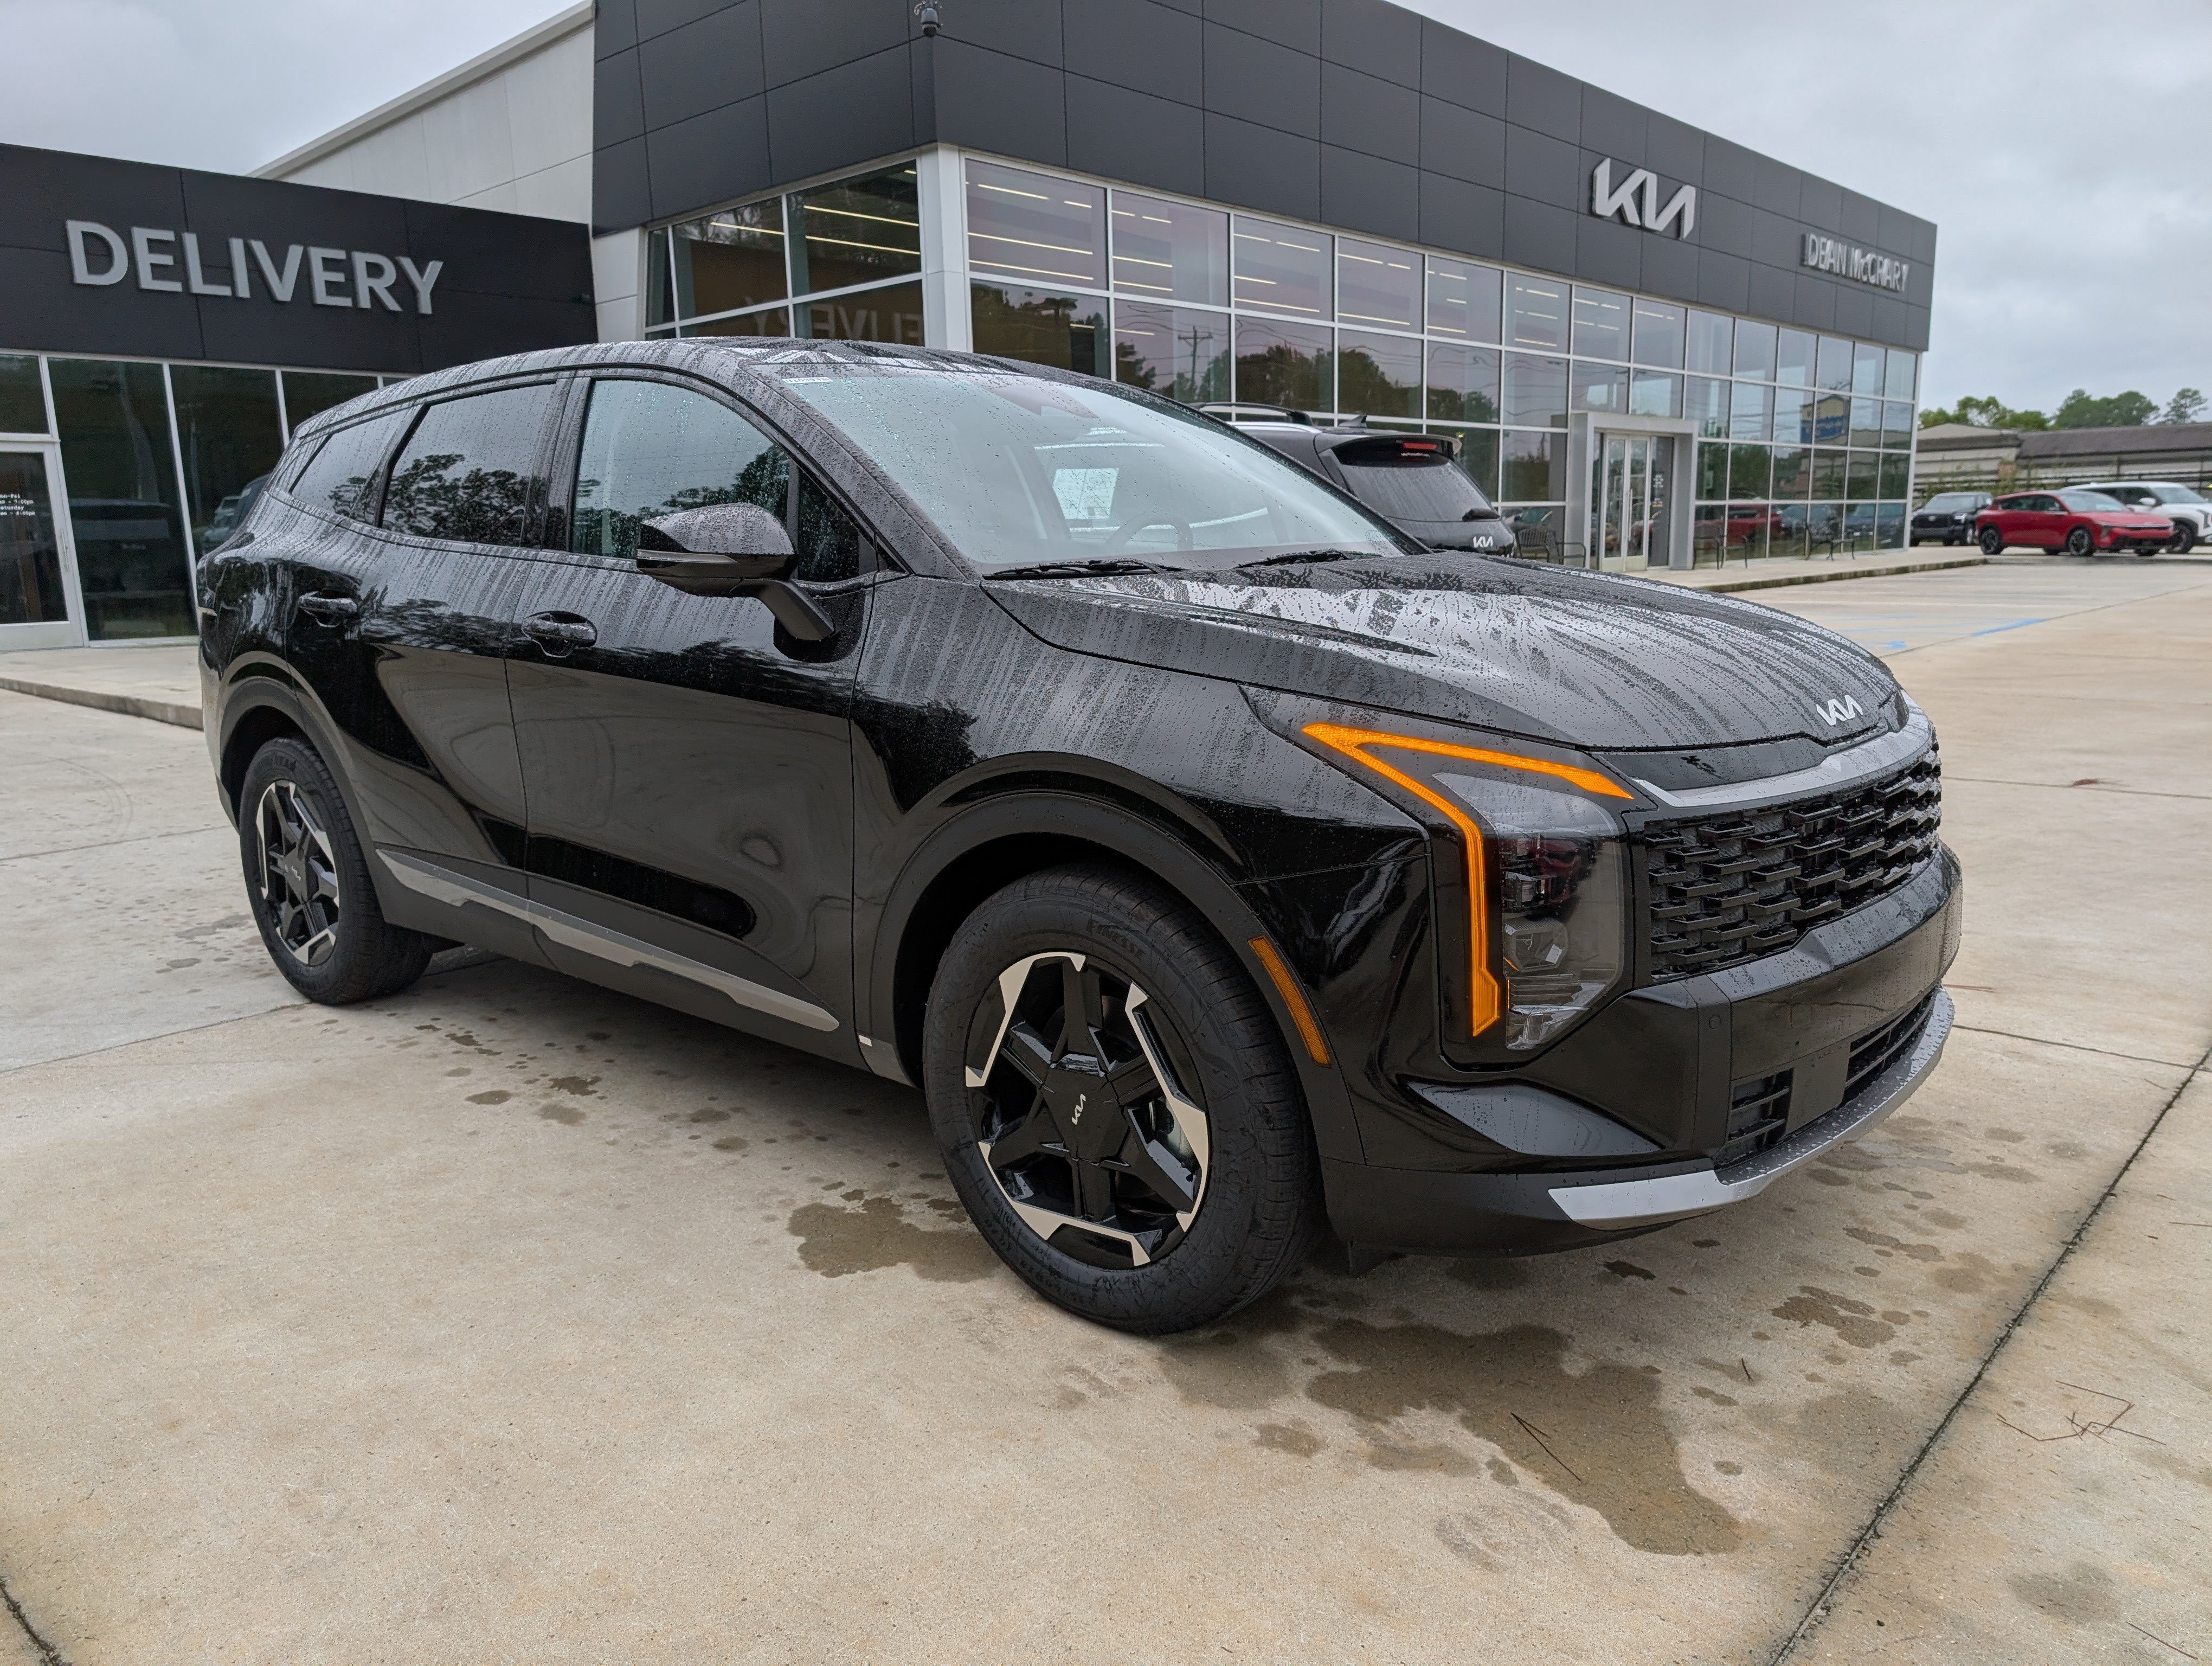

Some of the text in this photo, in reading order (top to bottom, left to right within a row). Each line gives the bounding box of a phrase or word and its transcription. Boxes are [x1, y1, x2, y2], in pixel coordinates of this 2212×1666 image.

[1592, 157, 1696, 239] KIA
[65, 219, 443, 315] DELIVERY
[1804, 233, 1909, 291] DEAN McCRARY
[1473, 536, 1493, 548] KIA
[1816, 695, 1863, 726] KIA
[1071, 1093, 1086, 1125] KIA
